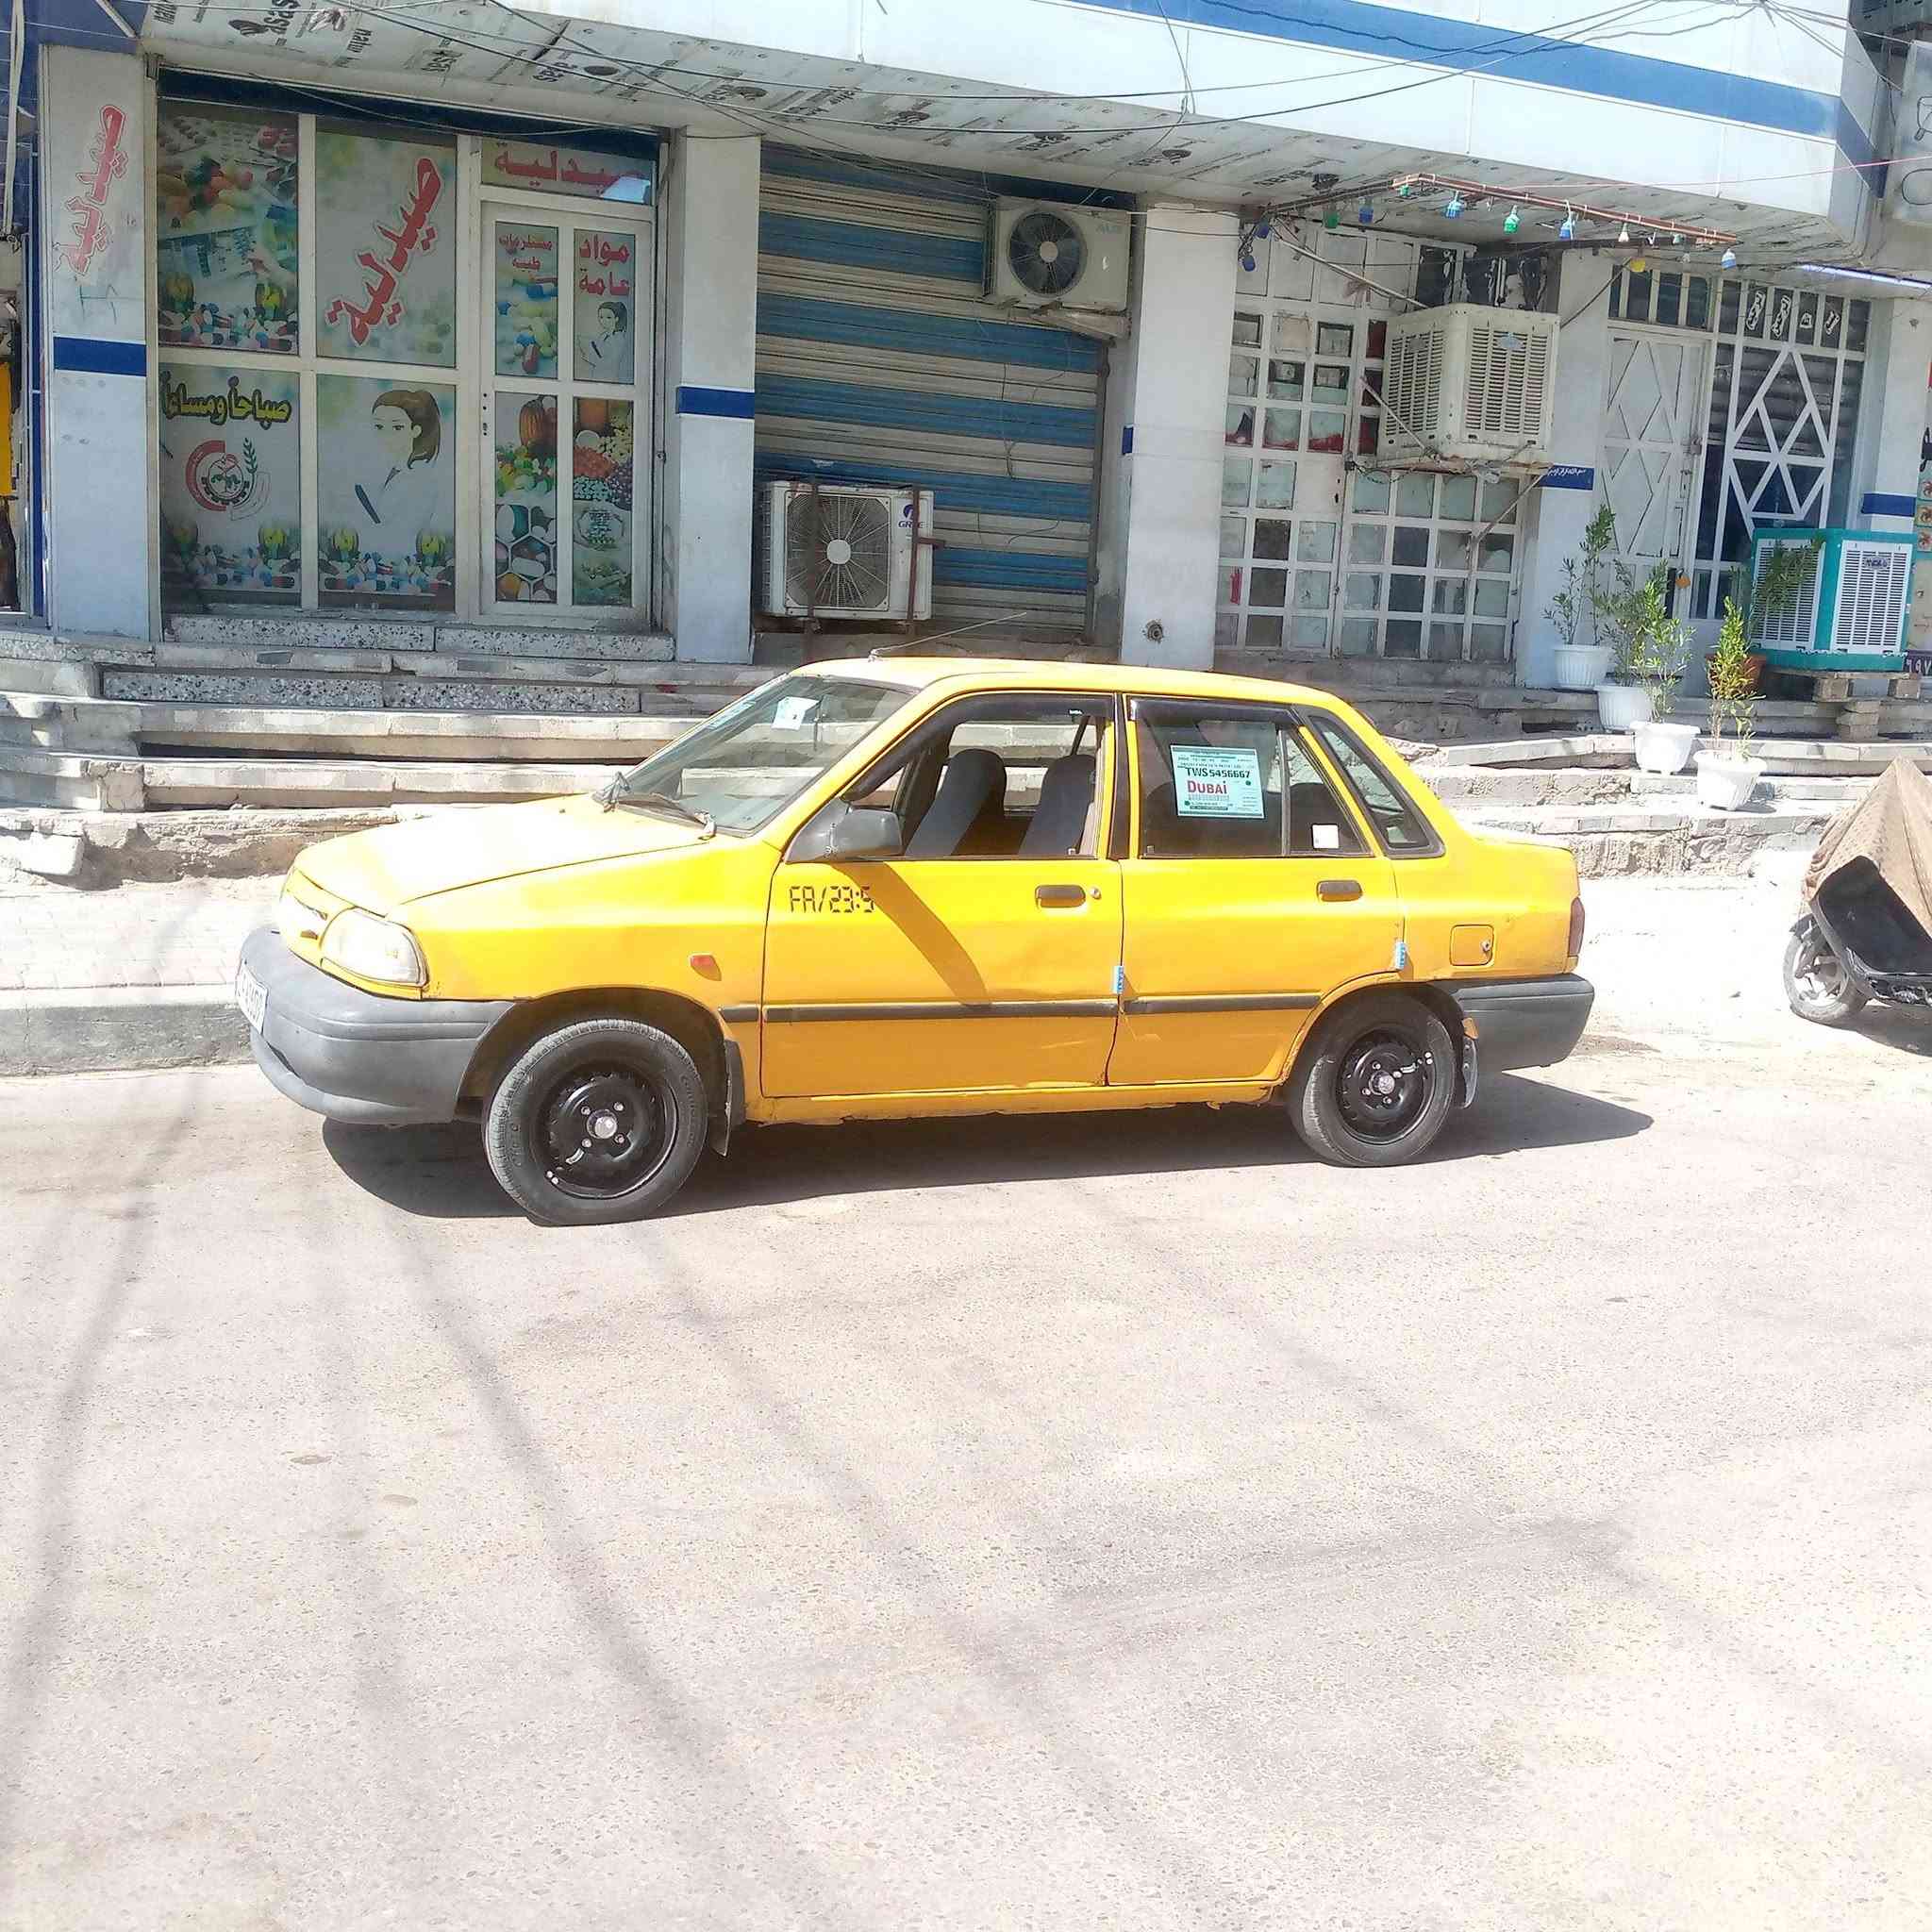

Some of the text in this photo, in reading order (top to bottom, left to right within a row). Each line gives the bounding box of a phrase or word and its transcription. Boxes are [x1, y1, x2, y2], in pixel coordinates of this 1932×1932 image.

[326, 157, 441, 346] صيدلية
[579, 234, 630, 267] مواد
[898, 520, 928, 528] GRE
